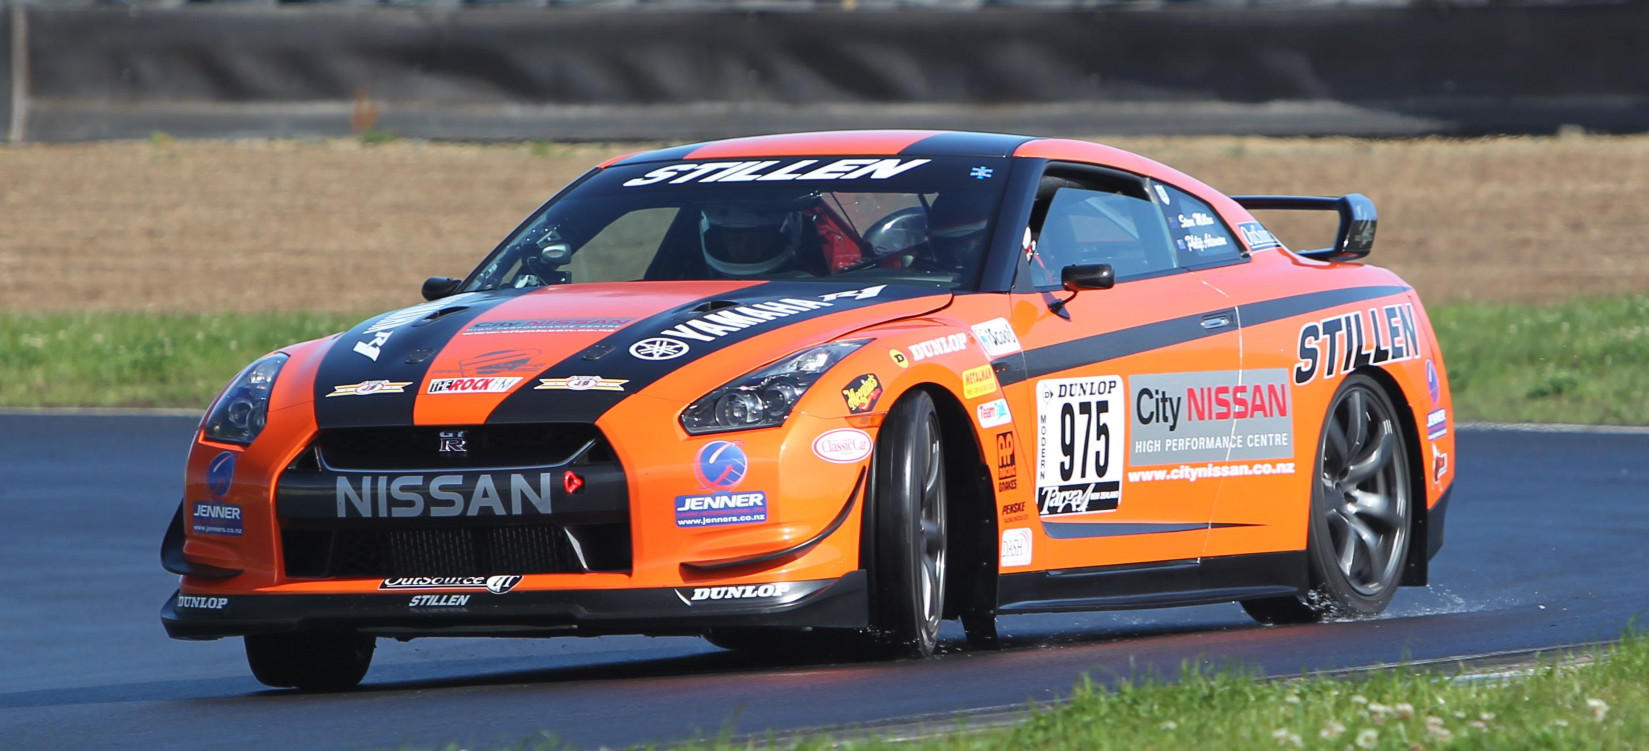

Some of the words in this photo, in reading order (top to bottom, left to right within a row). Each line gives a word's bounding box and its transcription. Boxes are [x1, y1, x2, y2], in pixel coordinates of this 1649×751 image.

[623, 159, 931, 187] STILLEN
[661, 298, 834, 342] YAMAHA
[908, 332, 968, 361] DUNLOP
[1294, 303, 1421, 385] STILLEN
[1058, 380, 1117, 398] DUNLOP
[1136, 387, 1181, 432] City
[1186, 383, 1288, 421] NISSAN
[1060, 400, 1110, 482] 975
[1135, 440, 1161, 453] HIGH
[1165, 435, 1243, 451] PERFORMANCE
[1246, 432, 1288, 447] CENTRE
[1127, 462, 1295, 483] www.citynissan.co.nz
[336, 472, 552, 518] NISSAN
[677, 493, 764, 511] JENNER
[193, 504, 241, 519] JENNER
[677, 513, 766, 526] www.jenners.co.nz
[177, 596, 229, 609] DUNLOP
[408, 595, 470, 607] STILLEN
[691, 584, 790, 601] DUNLOP
